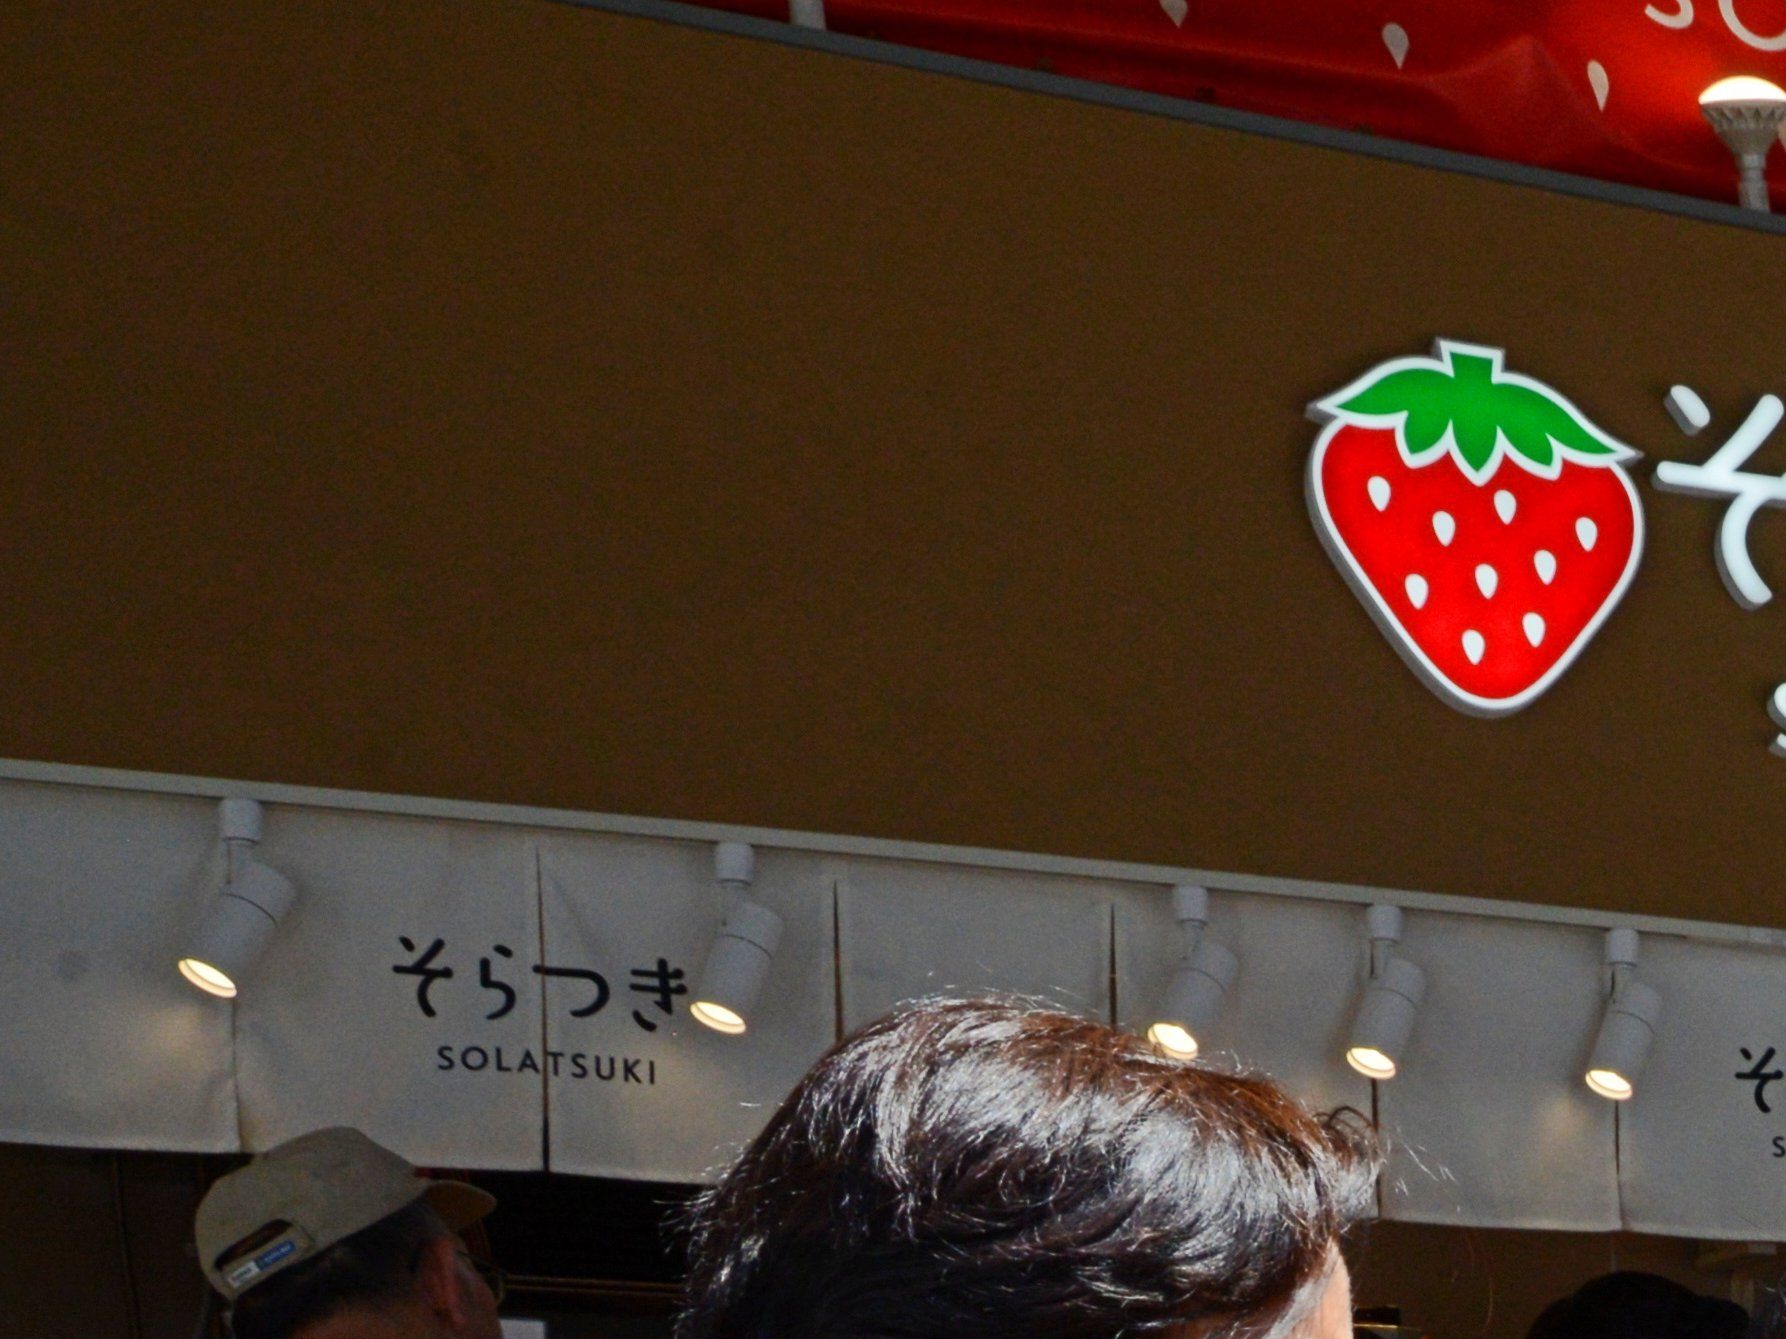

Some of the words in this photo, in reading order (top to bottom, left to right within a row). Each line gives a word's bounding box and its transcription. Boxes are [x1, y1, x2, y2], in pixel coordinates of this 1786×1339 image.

[391, 935, 688, 1033] そらつき
[436, 1045, 656, 1086] SOLATSUKI
